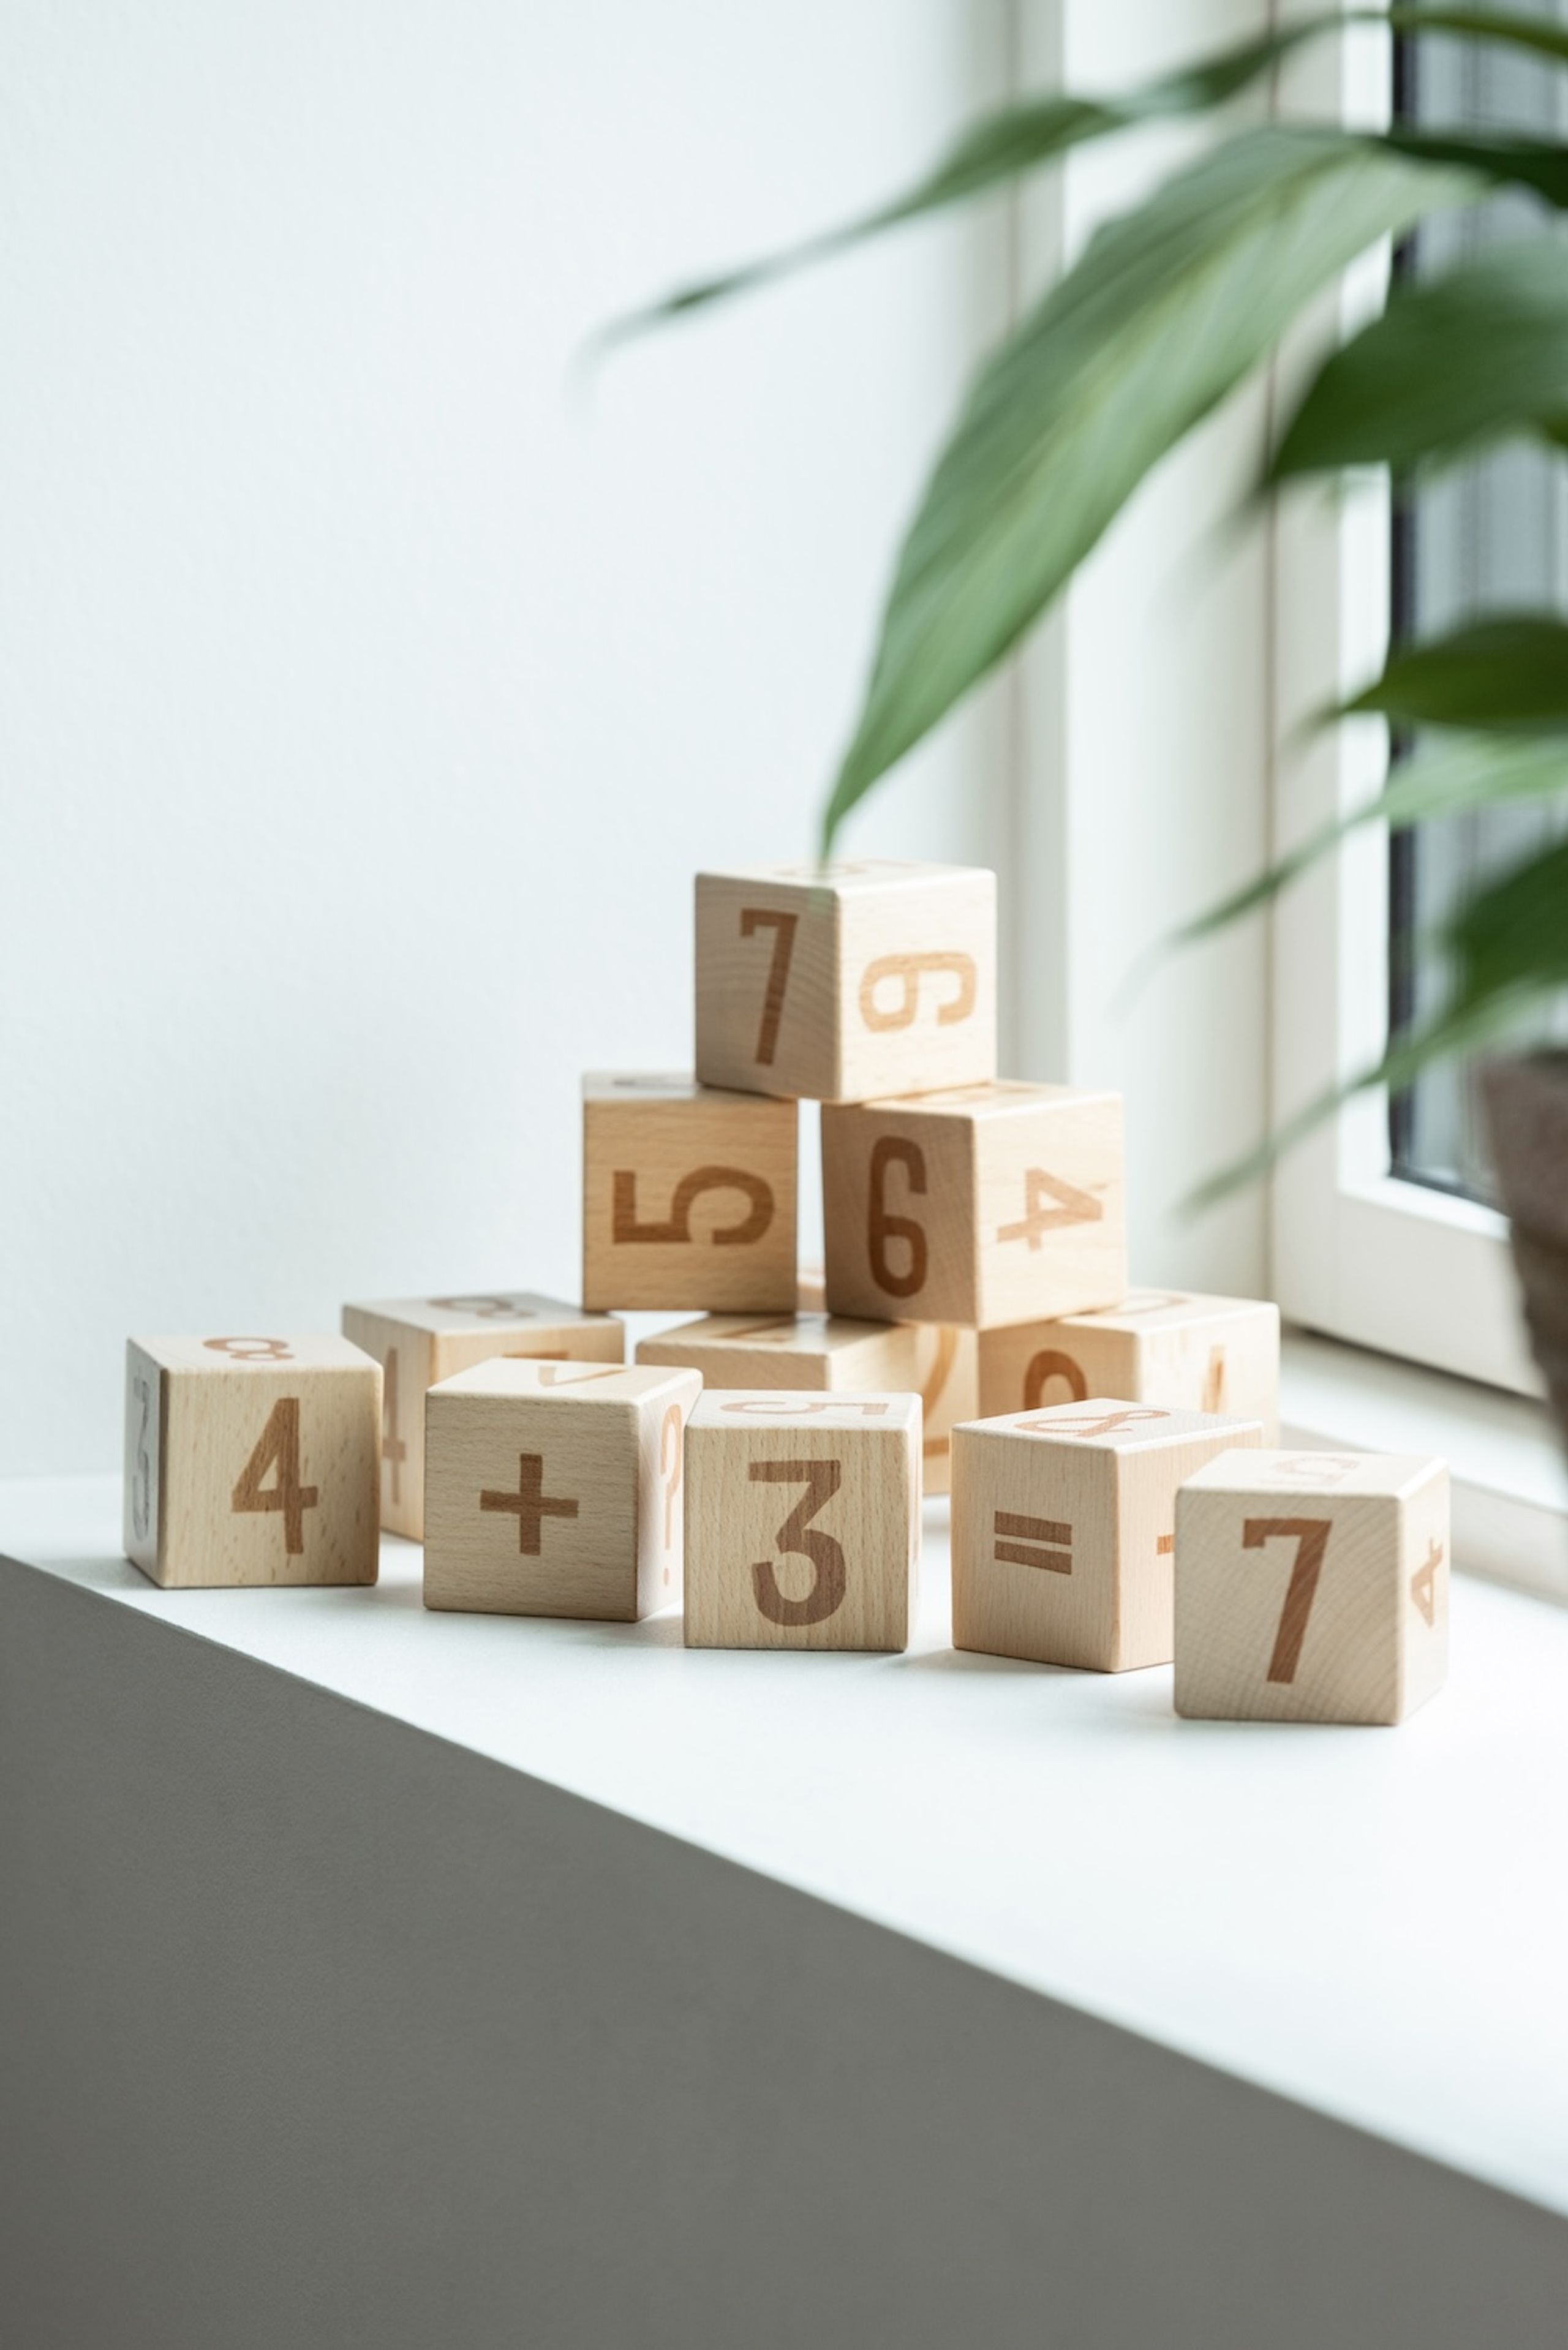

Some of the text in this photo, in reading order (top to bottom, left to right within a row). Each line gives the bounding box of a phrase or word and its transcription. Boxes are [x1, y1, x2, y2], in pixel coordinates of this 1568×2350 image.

[741, 908, 799, 1066] 7
[613, 1166, 775, 1246] 5
[868, 1135, 929, 1299] 6
[997, 1166, 1103, 1252] 4
[202, 1337, 295, 1361] 8
[720, 1401, 889, 1415] 5
[1014, 1409, 1170, 1437] &
[661, 1404, 681, 1587] ?
[231, 1397, 318, 1554] 4
[480, 1452, 579, 1556] +
[748, 1459, 846, 1627] 3
[994, 1510, 1072, 1575] =
[1242, 1518, 1333, 1684] 7
[1411, 1537, 1443, 1629] 4
